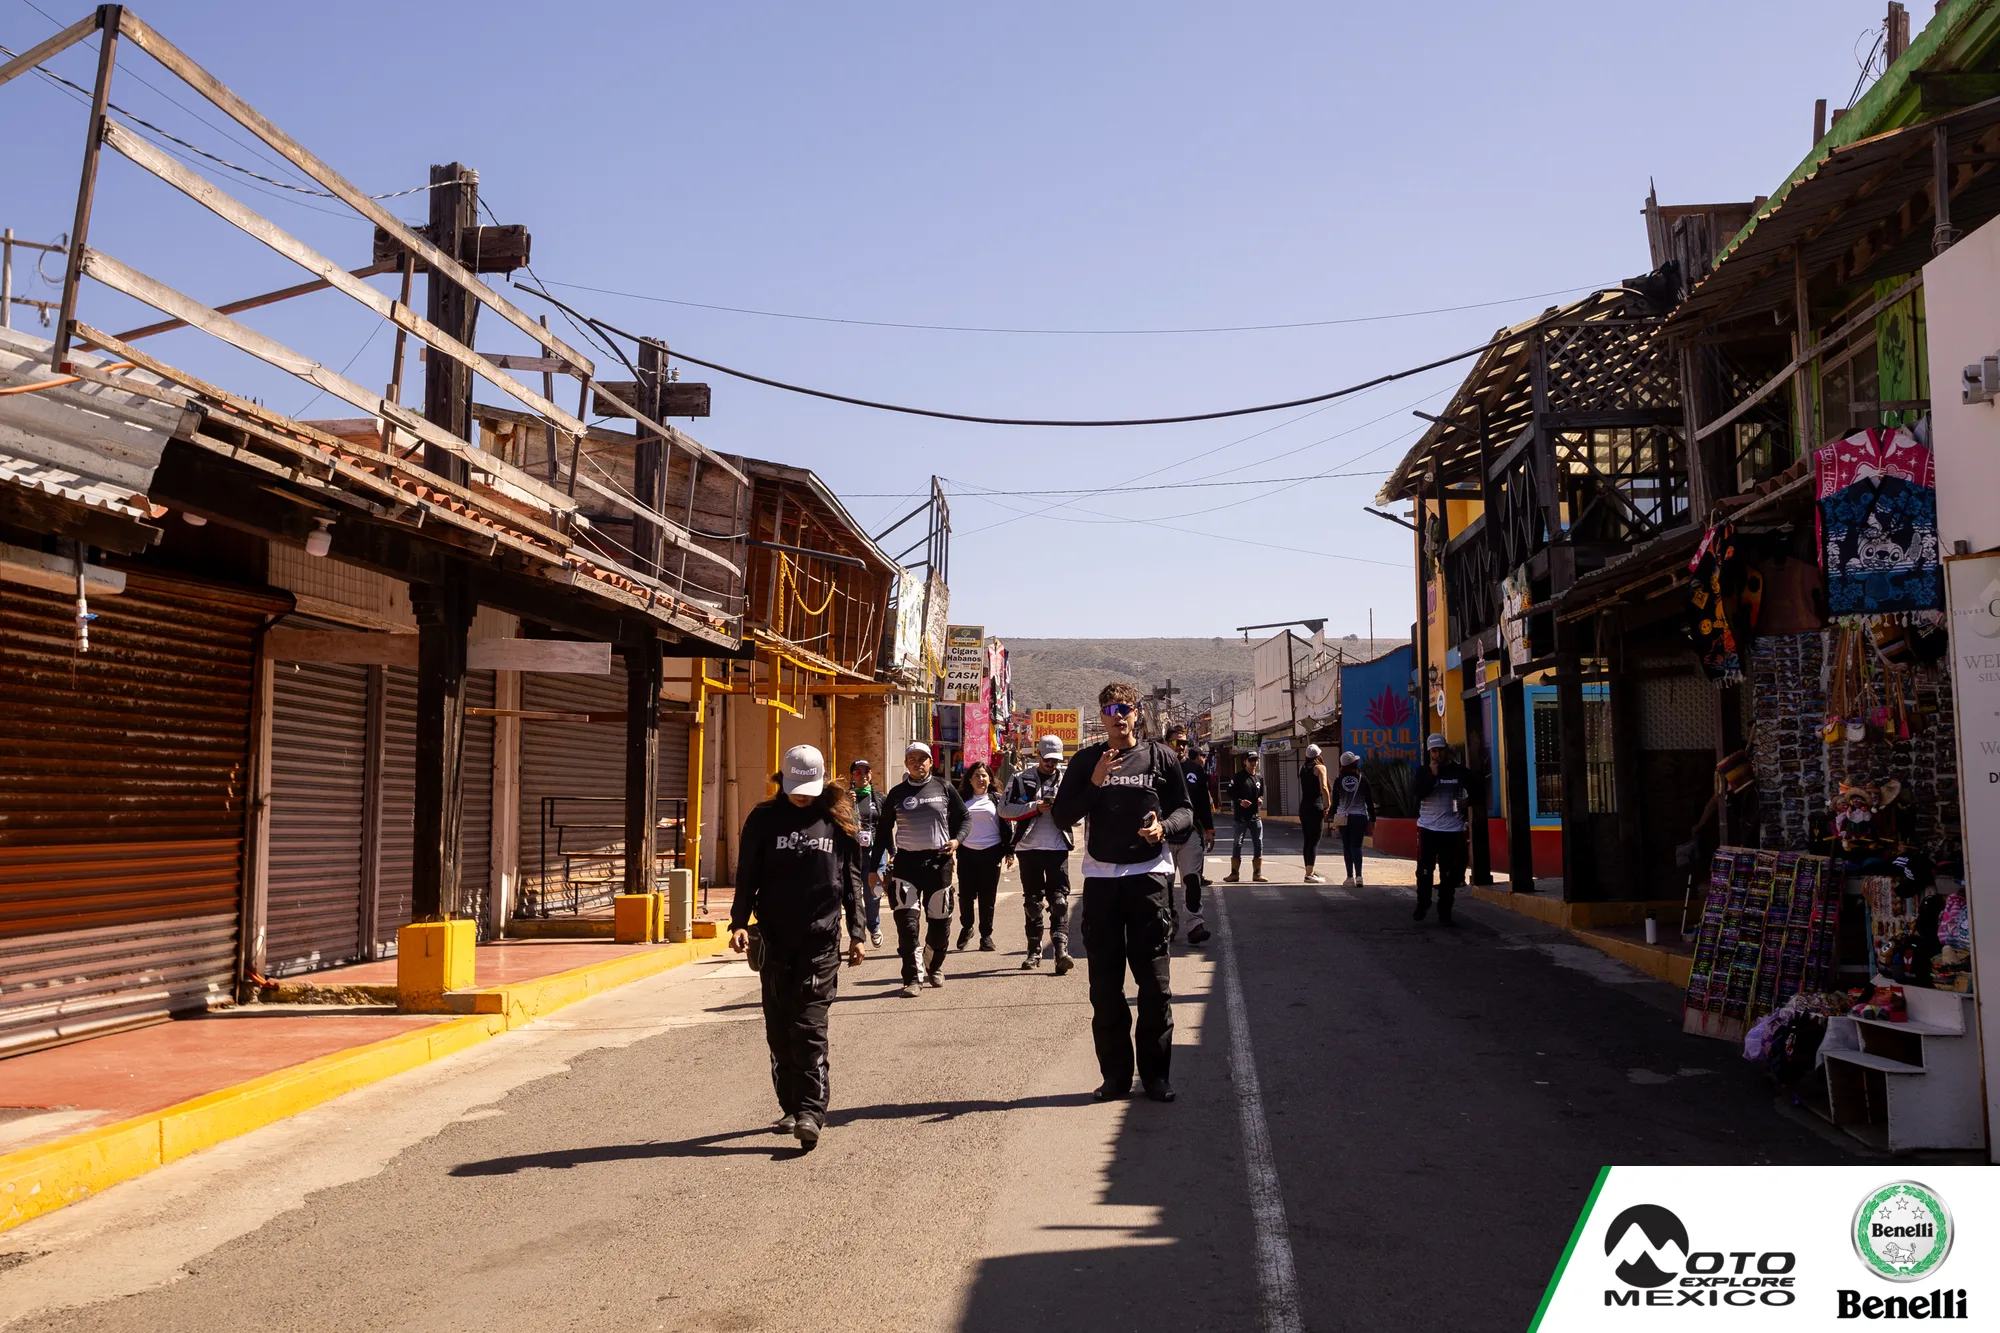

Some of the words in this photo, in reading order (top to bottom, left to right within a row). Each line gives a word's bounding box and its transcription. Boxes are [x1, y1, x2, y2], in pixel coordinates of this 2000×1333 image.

[1823, 472, 1836, 498] Hell
[1953, 608, 1985, 616] SILVER
[951, 647, 978, 656] Cigars
[947, 654, 981, 662] Habanos
[948, 671, 979, 679] CASH
[947, 682, 977, 690] BACK
[1035, 711, 1077, 724] Cigars
[1035, 725, 1077, 740] Habanos
[791, 766, 818, 775] Benelli
[1101, 773, 1156, 787] Benelli
[776, 836, 833, 853] Beelli
